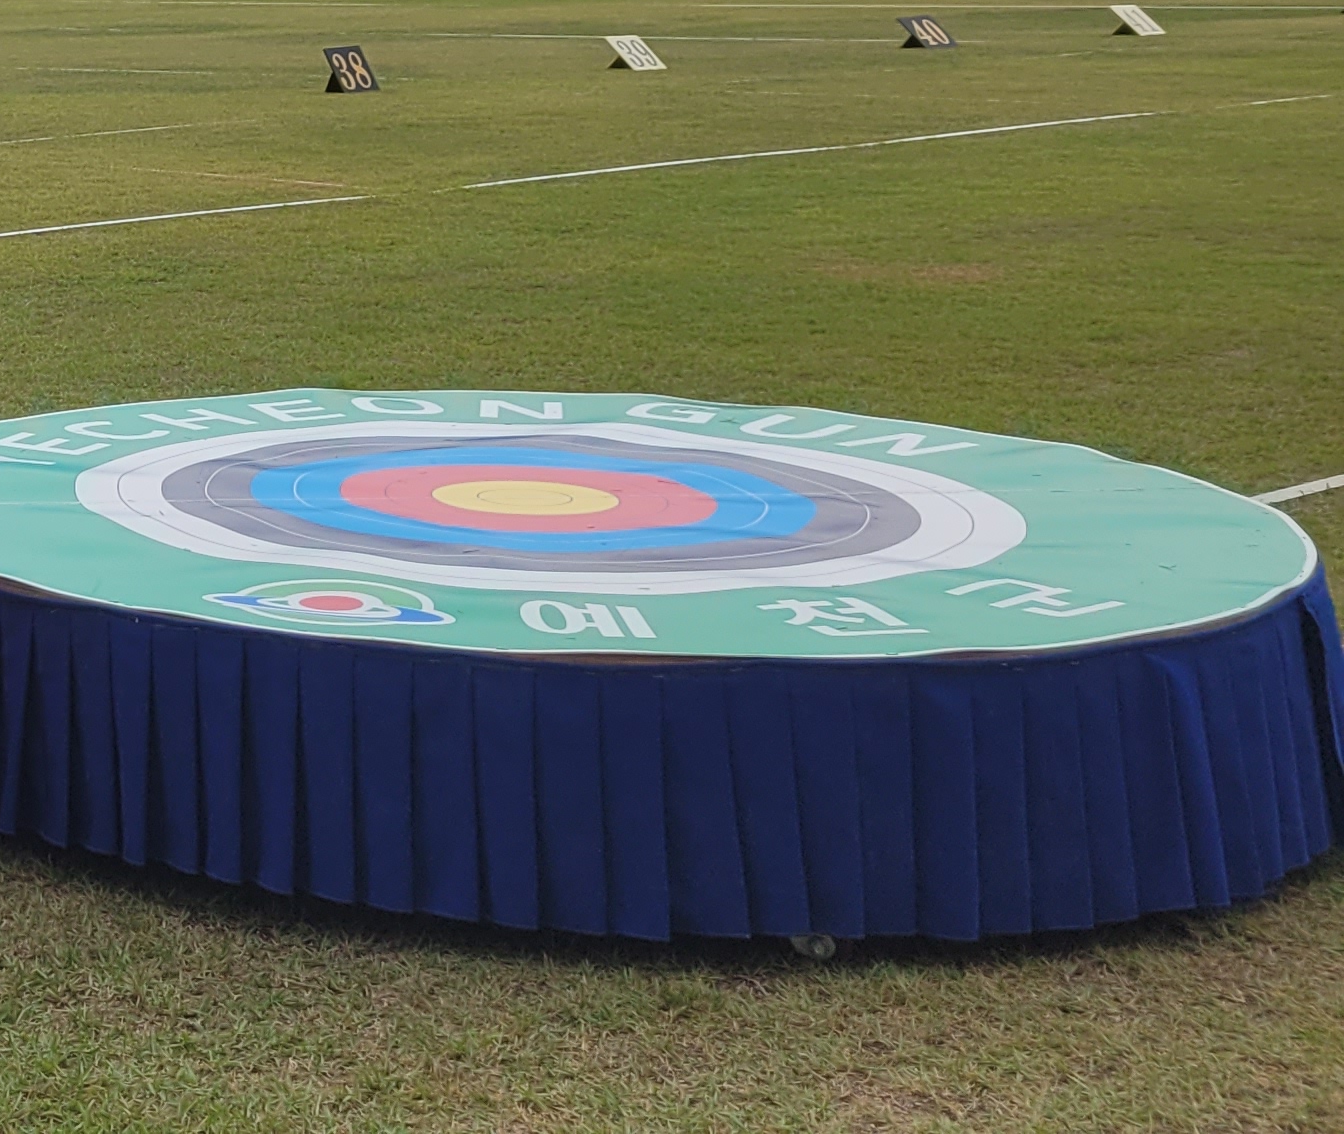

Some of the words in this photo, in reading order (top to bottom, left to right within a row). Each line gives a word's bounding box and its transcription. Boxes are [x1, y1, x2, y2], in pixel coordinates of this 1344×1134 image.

[911, 17, 951, 46] 40
[1122, 9, 1162, 33] 41
[615, 39, 657, 68] 39
[331, 51, 373, 91] 38
[625, 401, 979, 457] GUN
